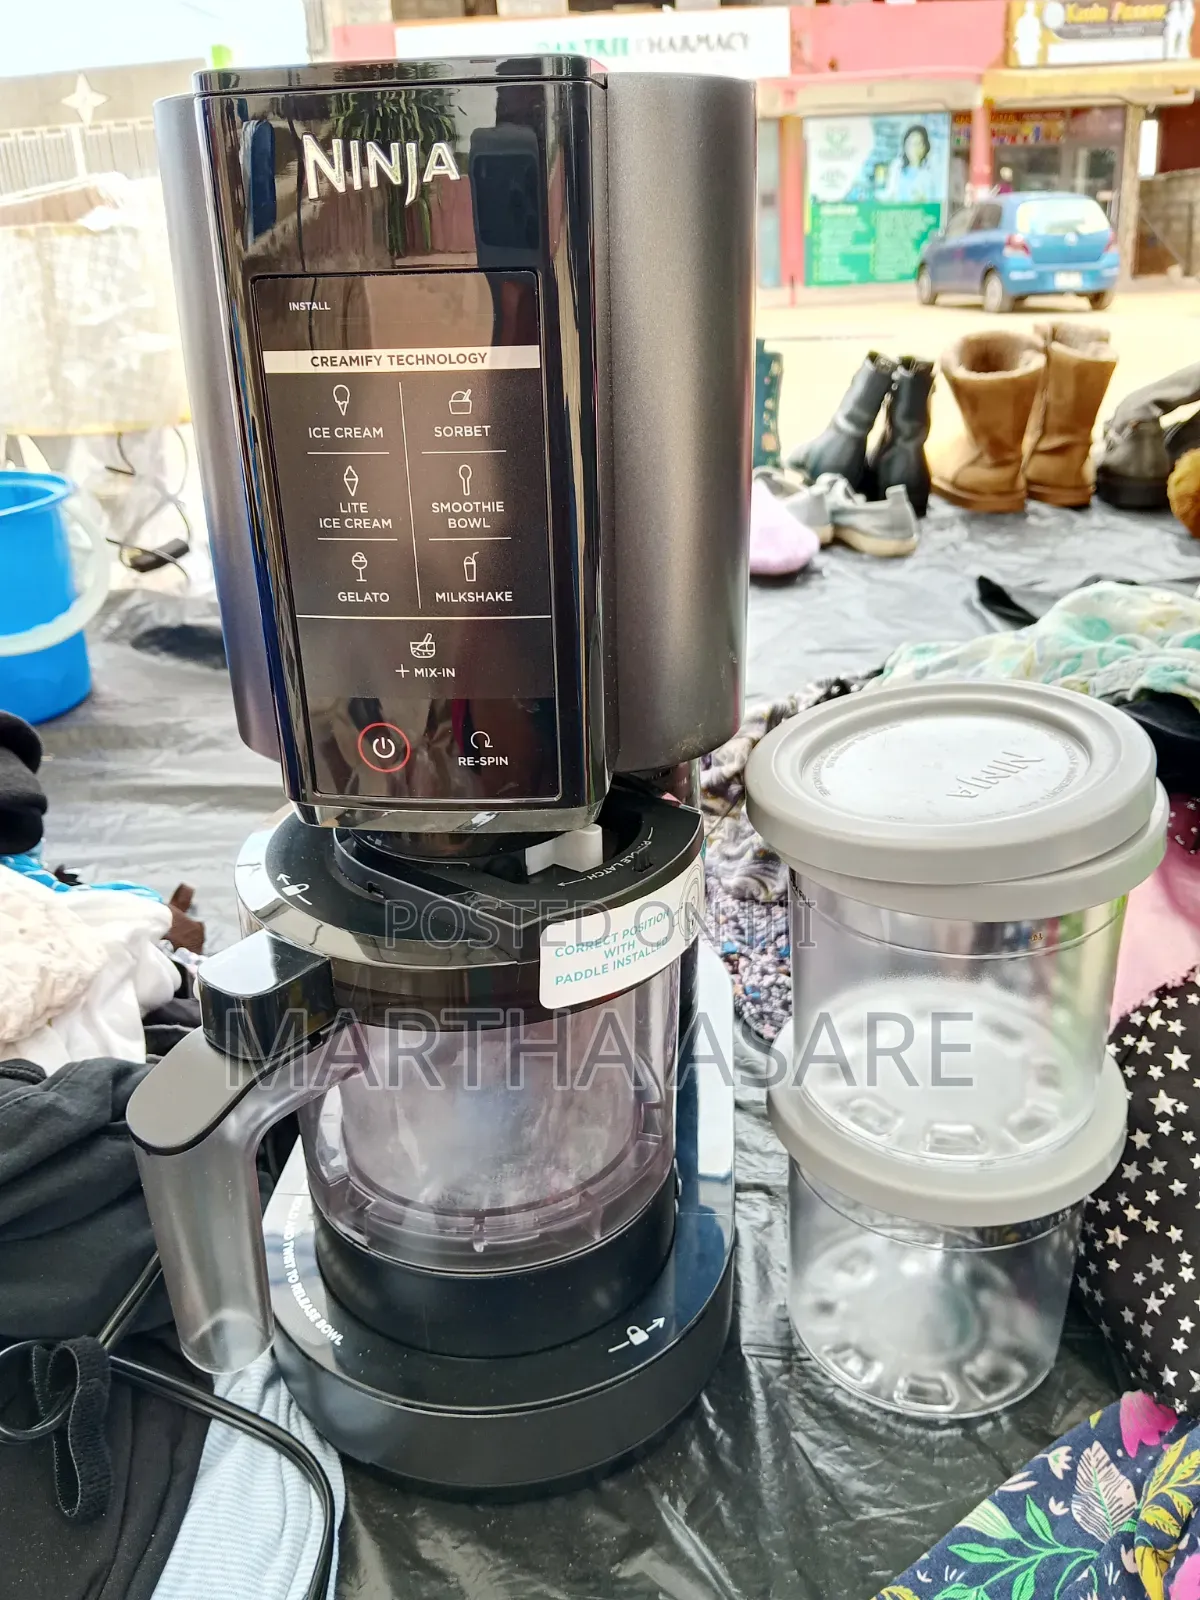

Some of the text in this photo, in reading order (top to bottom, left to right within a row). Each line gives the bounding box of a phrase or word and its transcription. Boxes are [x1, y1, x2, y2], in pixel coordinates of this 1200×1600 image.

[302, 134, 461, 206] NINJA
[289, 301, 331, 312] INSTALL
[310, 352, 488, 368] CREAMIFY TECHNOLOGY
[308, 426, 384, 439] ICE CREAM
[433, 425, 491, 438] SORBET
[339, 502, 369, 513] LITE
[431, 501, 505, 513] SMOOTHIE
[319, 517, 393, 530] ICE CREAM
[447, 517, 491, 529] BOWL
[337, 591, 390, 603] GELATO
[435, 591, 513, 603] MILKSHAKE
[414, 667, 456, 678] MIX-IN
[458, 756, 509, 766] RE-SPIN
[945, 750, 1044, 799] NINJA
[586, 862, 624, 881] LATCH
[554, 908, 670, 958] CORRECT POSITION
[603, 939, 636, 960] WITH
[555, 936, 669, 986] PADDLE INSTALLED
[285, 1268, 300, 1284] TO
[290, 1282, 321, 1323] RELEASE
[314, 1318, 344, 1346] BOWL
